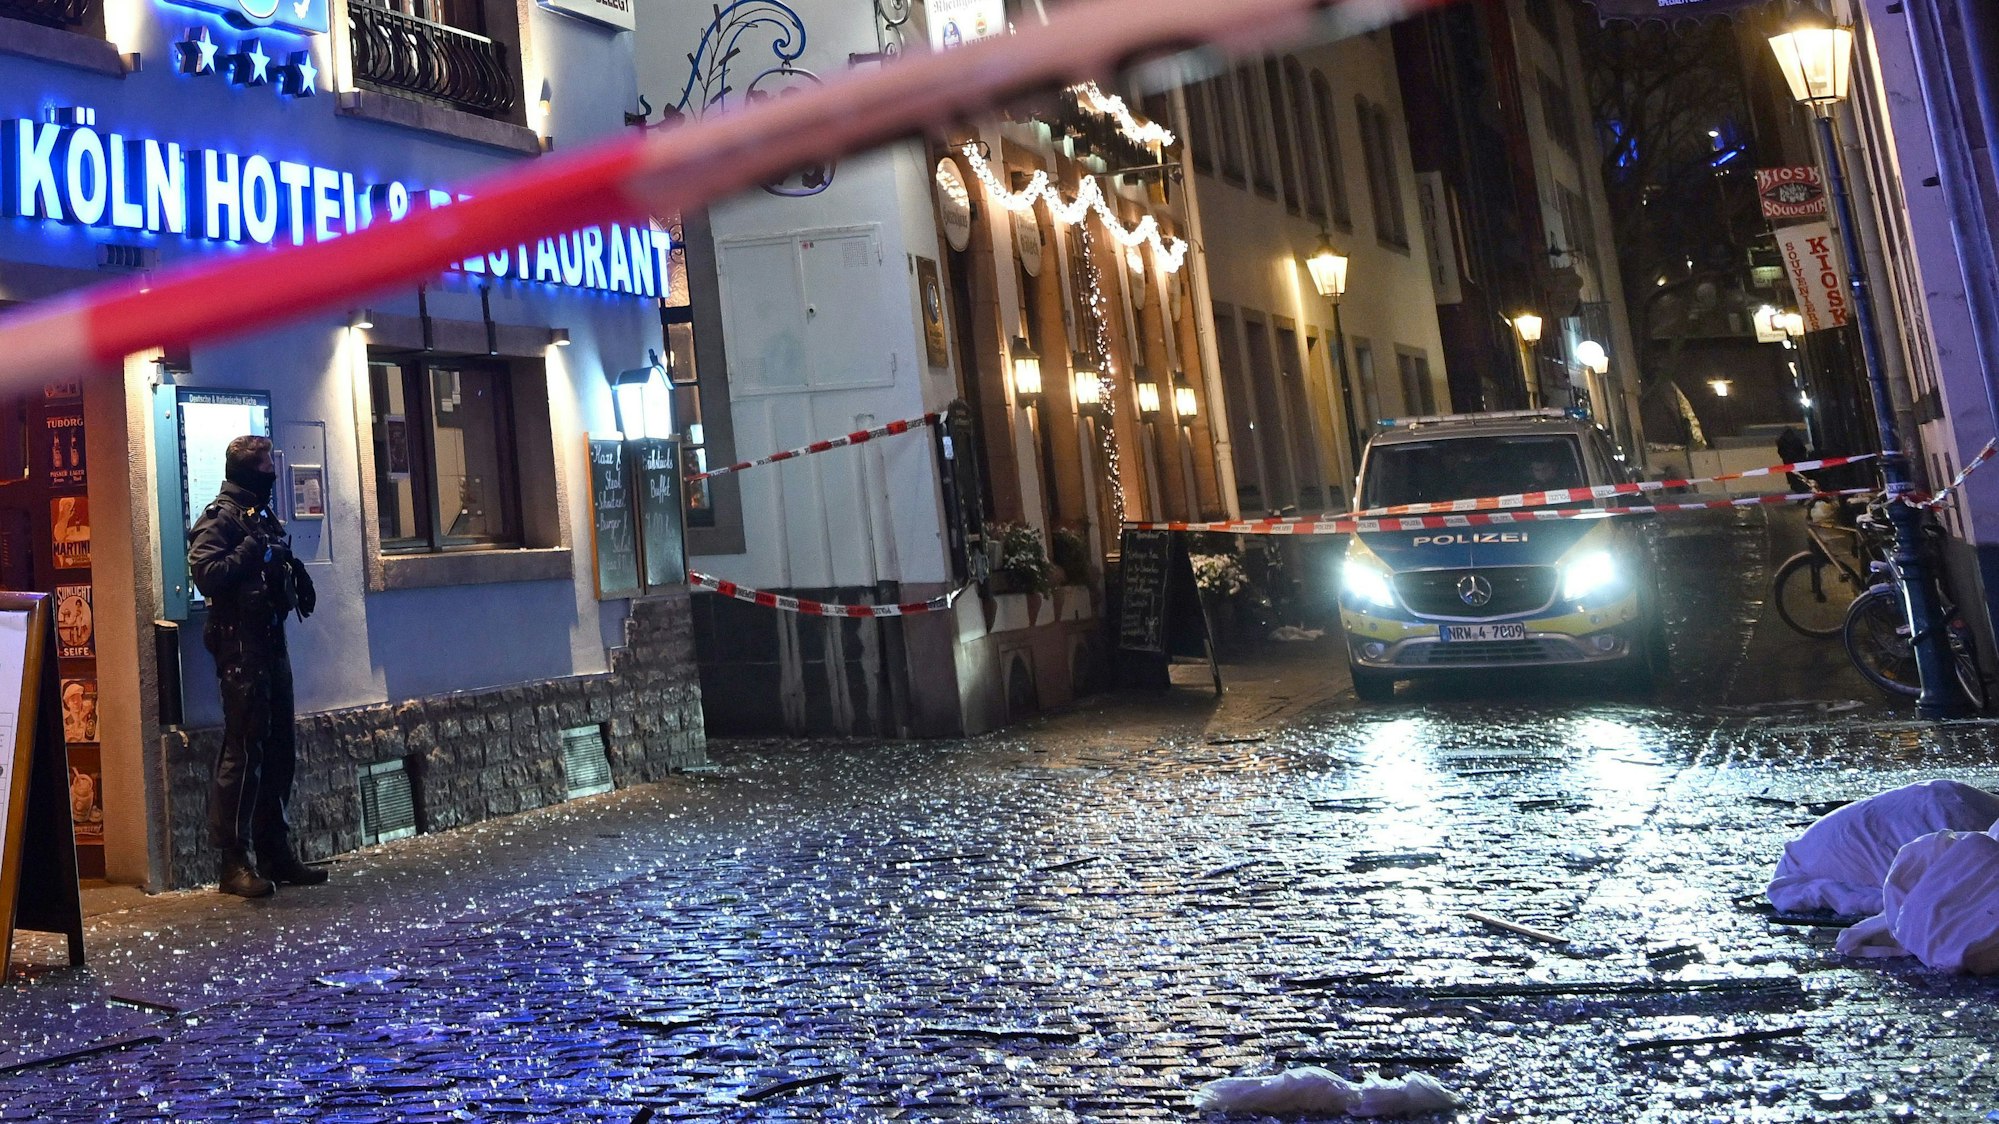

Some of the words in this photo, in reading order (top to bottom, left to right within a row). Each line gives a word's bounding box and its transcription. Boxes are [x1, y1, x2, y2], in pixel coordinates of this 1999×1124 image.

[17, 107, 183, 235] KÖLN
[205, 149, 357, 246] HOTEL
[1756, 166, 1821, 189] KIOSK
[1805, 236, 1847, 325] KIOSK
[47, 418, 84, 429] TUBORG
[1272, 524, 1292, 532] POLIZEI
[1357, 522, 1378, 530] POLIZEI
[1413, 532, 1528, 547] POLIZEI
[53, 540, 91, 556] MARTINI
[57, 585, 91, 605] SUNLIGHT
[1448, 627, 1472, 640] NRW
[63, 647, 90, 657] SEIFE
